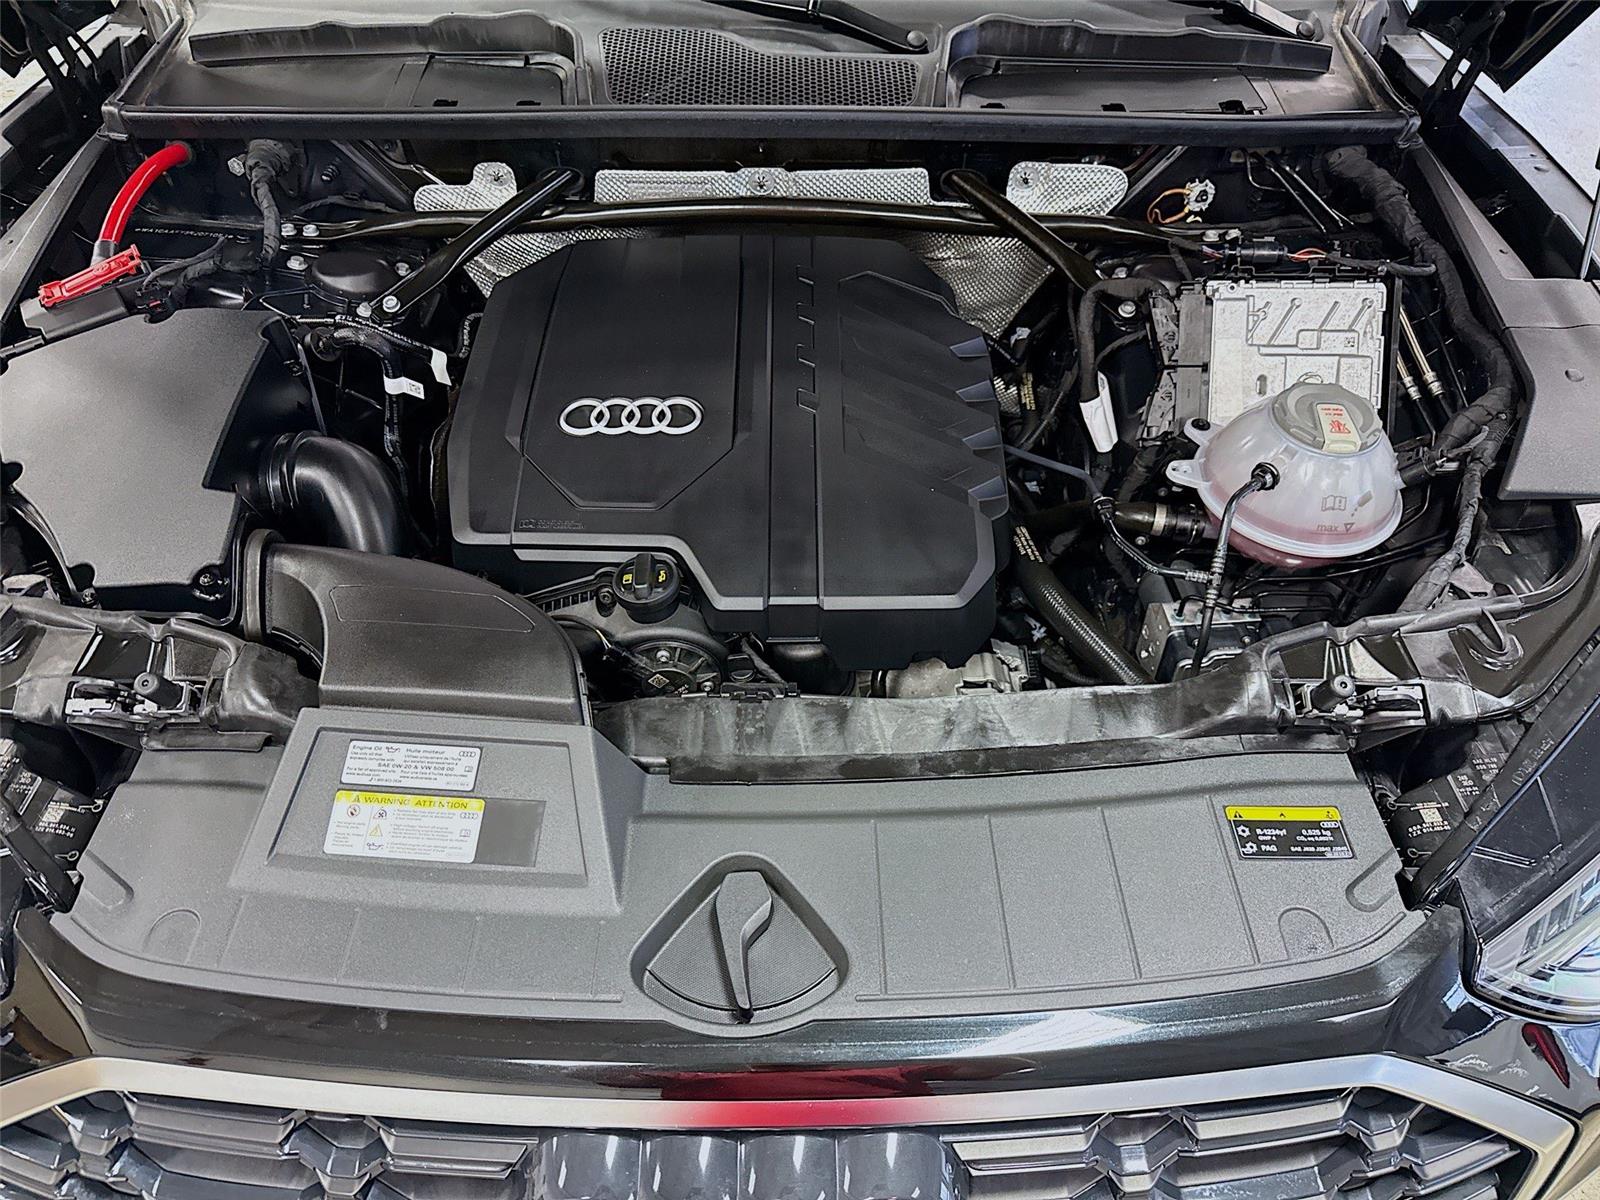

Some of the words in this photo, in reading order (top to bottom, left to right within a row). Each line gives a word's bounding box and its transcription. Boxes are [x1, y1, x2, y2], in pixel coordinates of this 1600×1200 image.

[1316, 524, 1338, 532] max
[364, 796, 410, 805] WARNING
[415, 799, 468, 809] ATTENTION
[1321, 829, 1332, 837] kg
[1260, 844, 1278, 852] PAG
